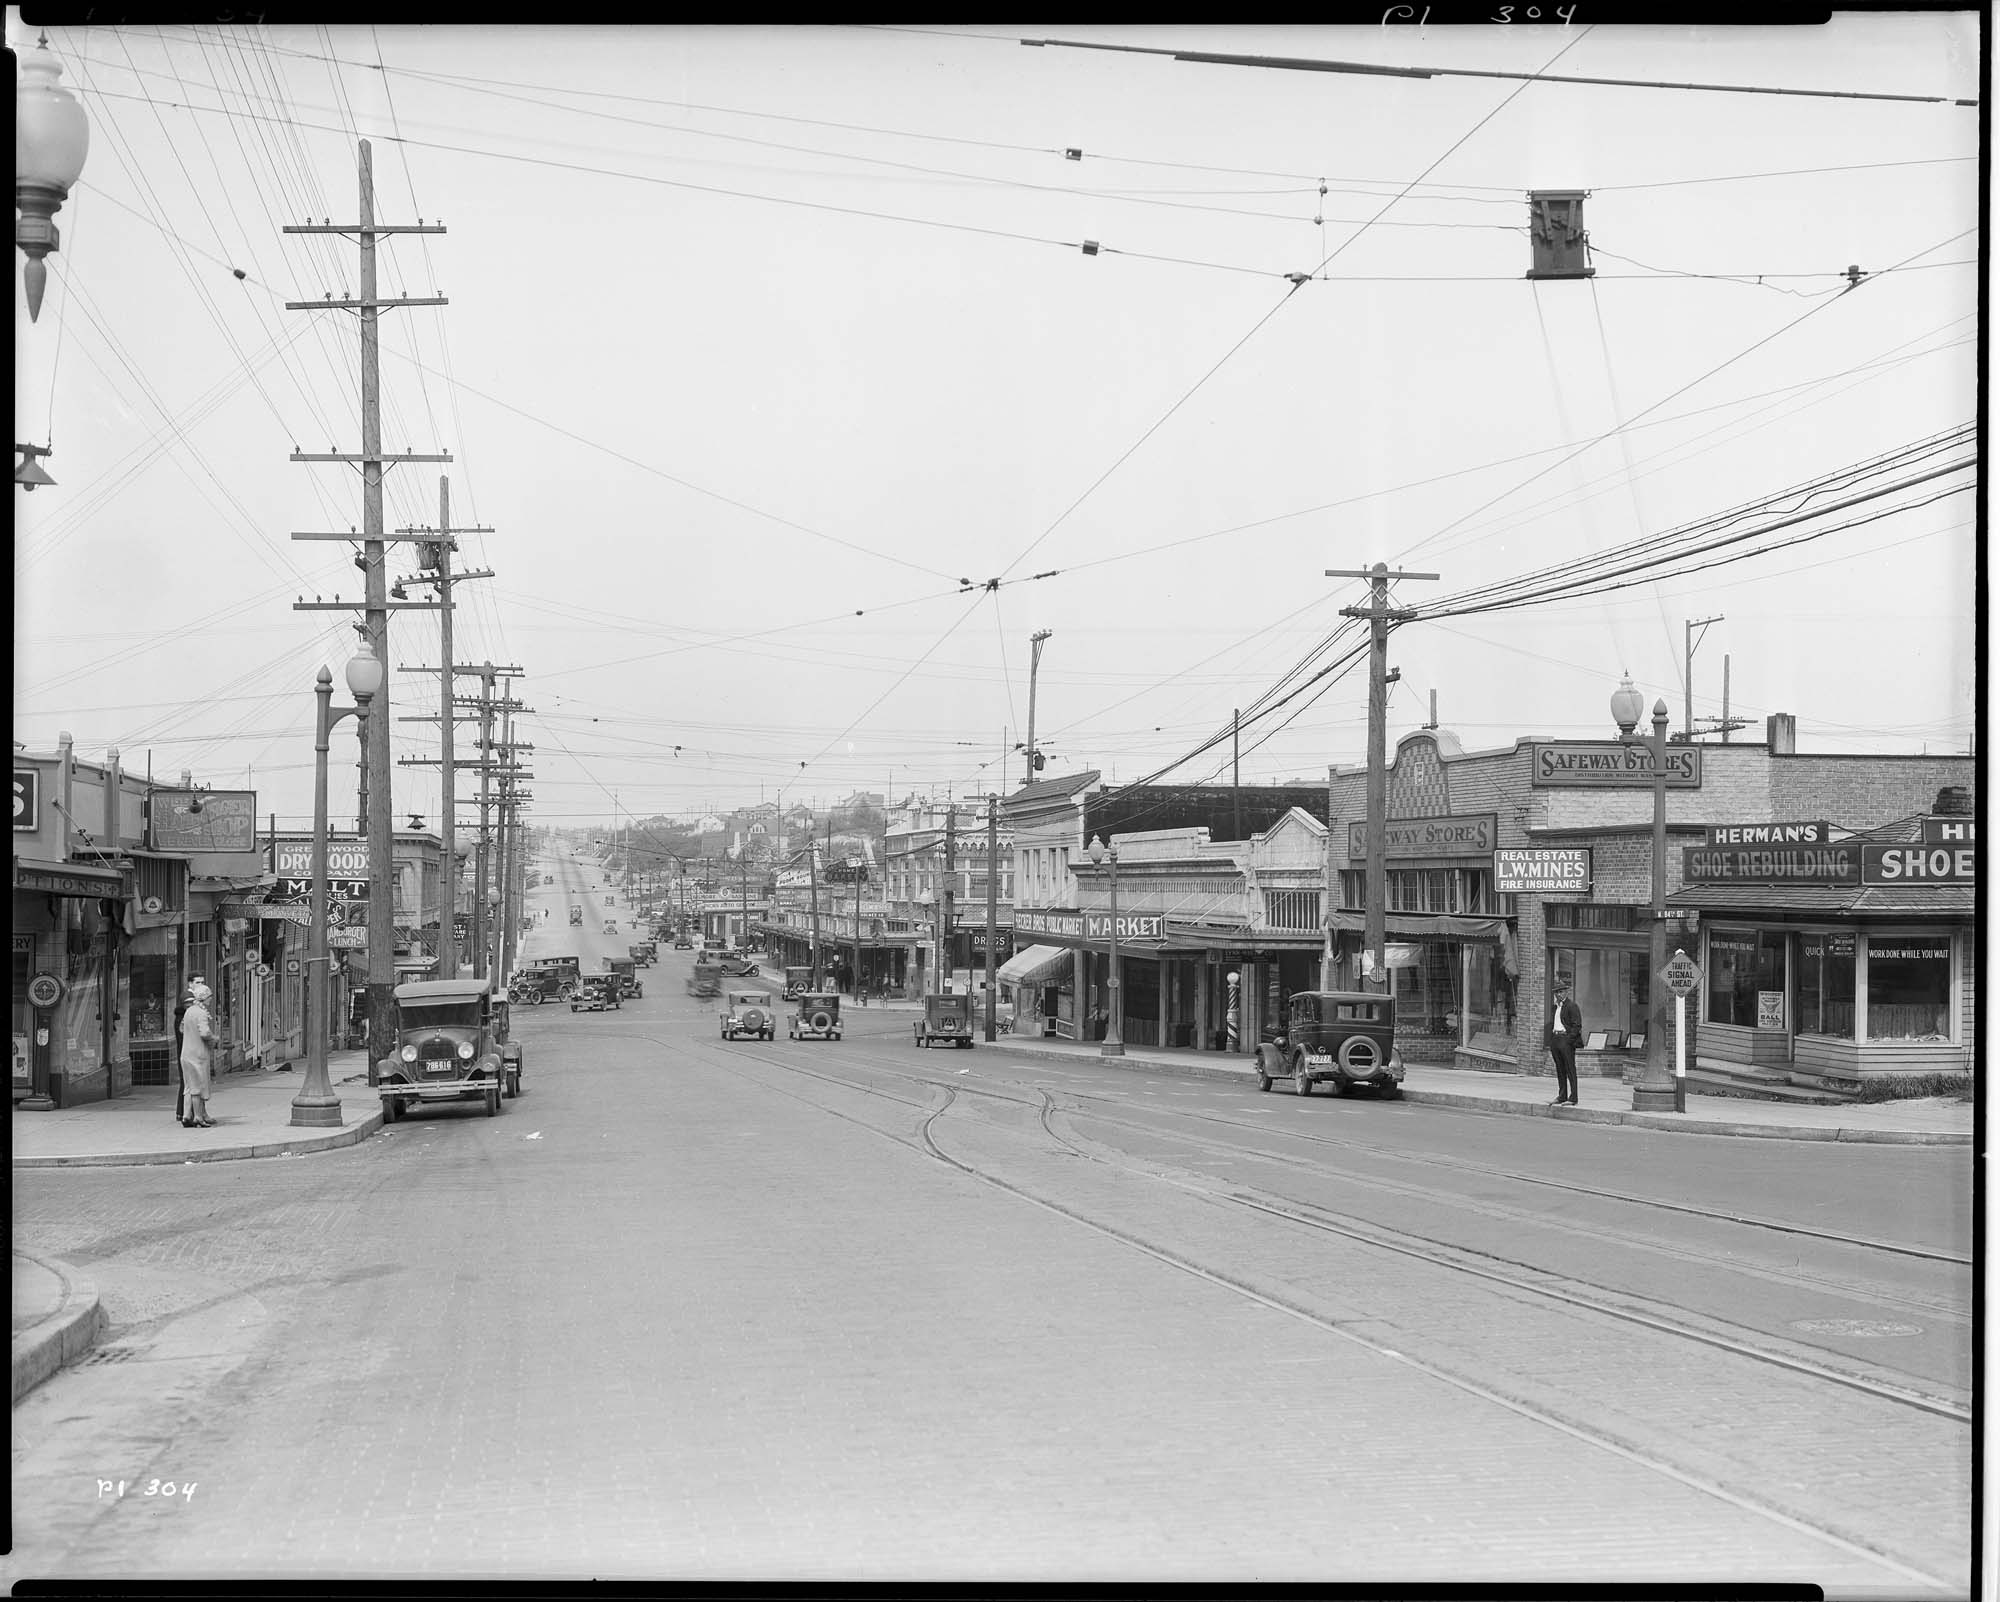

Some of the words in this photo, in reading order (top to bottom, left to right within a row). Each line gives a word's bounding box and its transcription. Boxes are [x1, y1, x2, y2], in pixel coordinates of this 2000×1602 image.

[1541, 750, 1622, 777] SAFEWAY
[1426, 821, 1487, 849] STORES
[1715, 825, 1818, 844] HERMAN'S
[280, 853, 312, 870] DRY
[1501, 852, 1532, 861] REAL
[1535, 852, 1582, 861] ESTATE
[1691, 850, 1732, 879] SHOE
[1737, 849, 1849, 879] REBUILDING
[287, 880, 365, 896] MLT
[1501, 880, 1523, 889] FIRE
[1526, 880, 1582, 889] INSURANCE
[1089, 917, 1160, 936] MARKET
[1805, 945, 1825, 957] QUICK
[1868, 949, 1886, 958] WORK
[1886, 949, 1900, 958] DONE
[1901, 949, 1921, 959] WHILE
[1921, 949, 1933, 959] YOU
[1934, 949, 1949, 959] WAIT
[1672, 962, 1692, 970] TRAFFIC
[1667, 971, 1695, 979] SIGNAL
[1671, 980, 1692, 988] AHEAD
